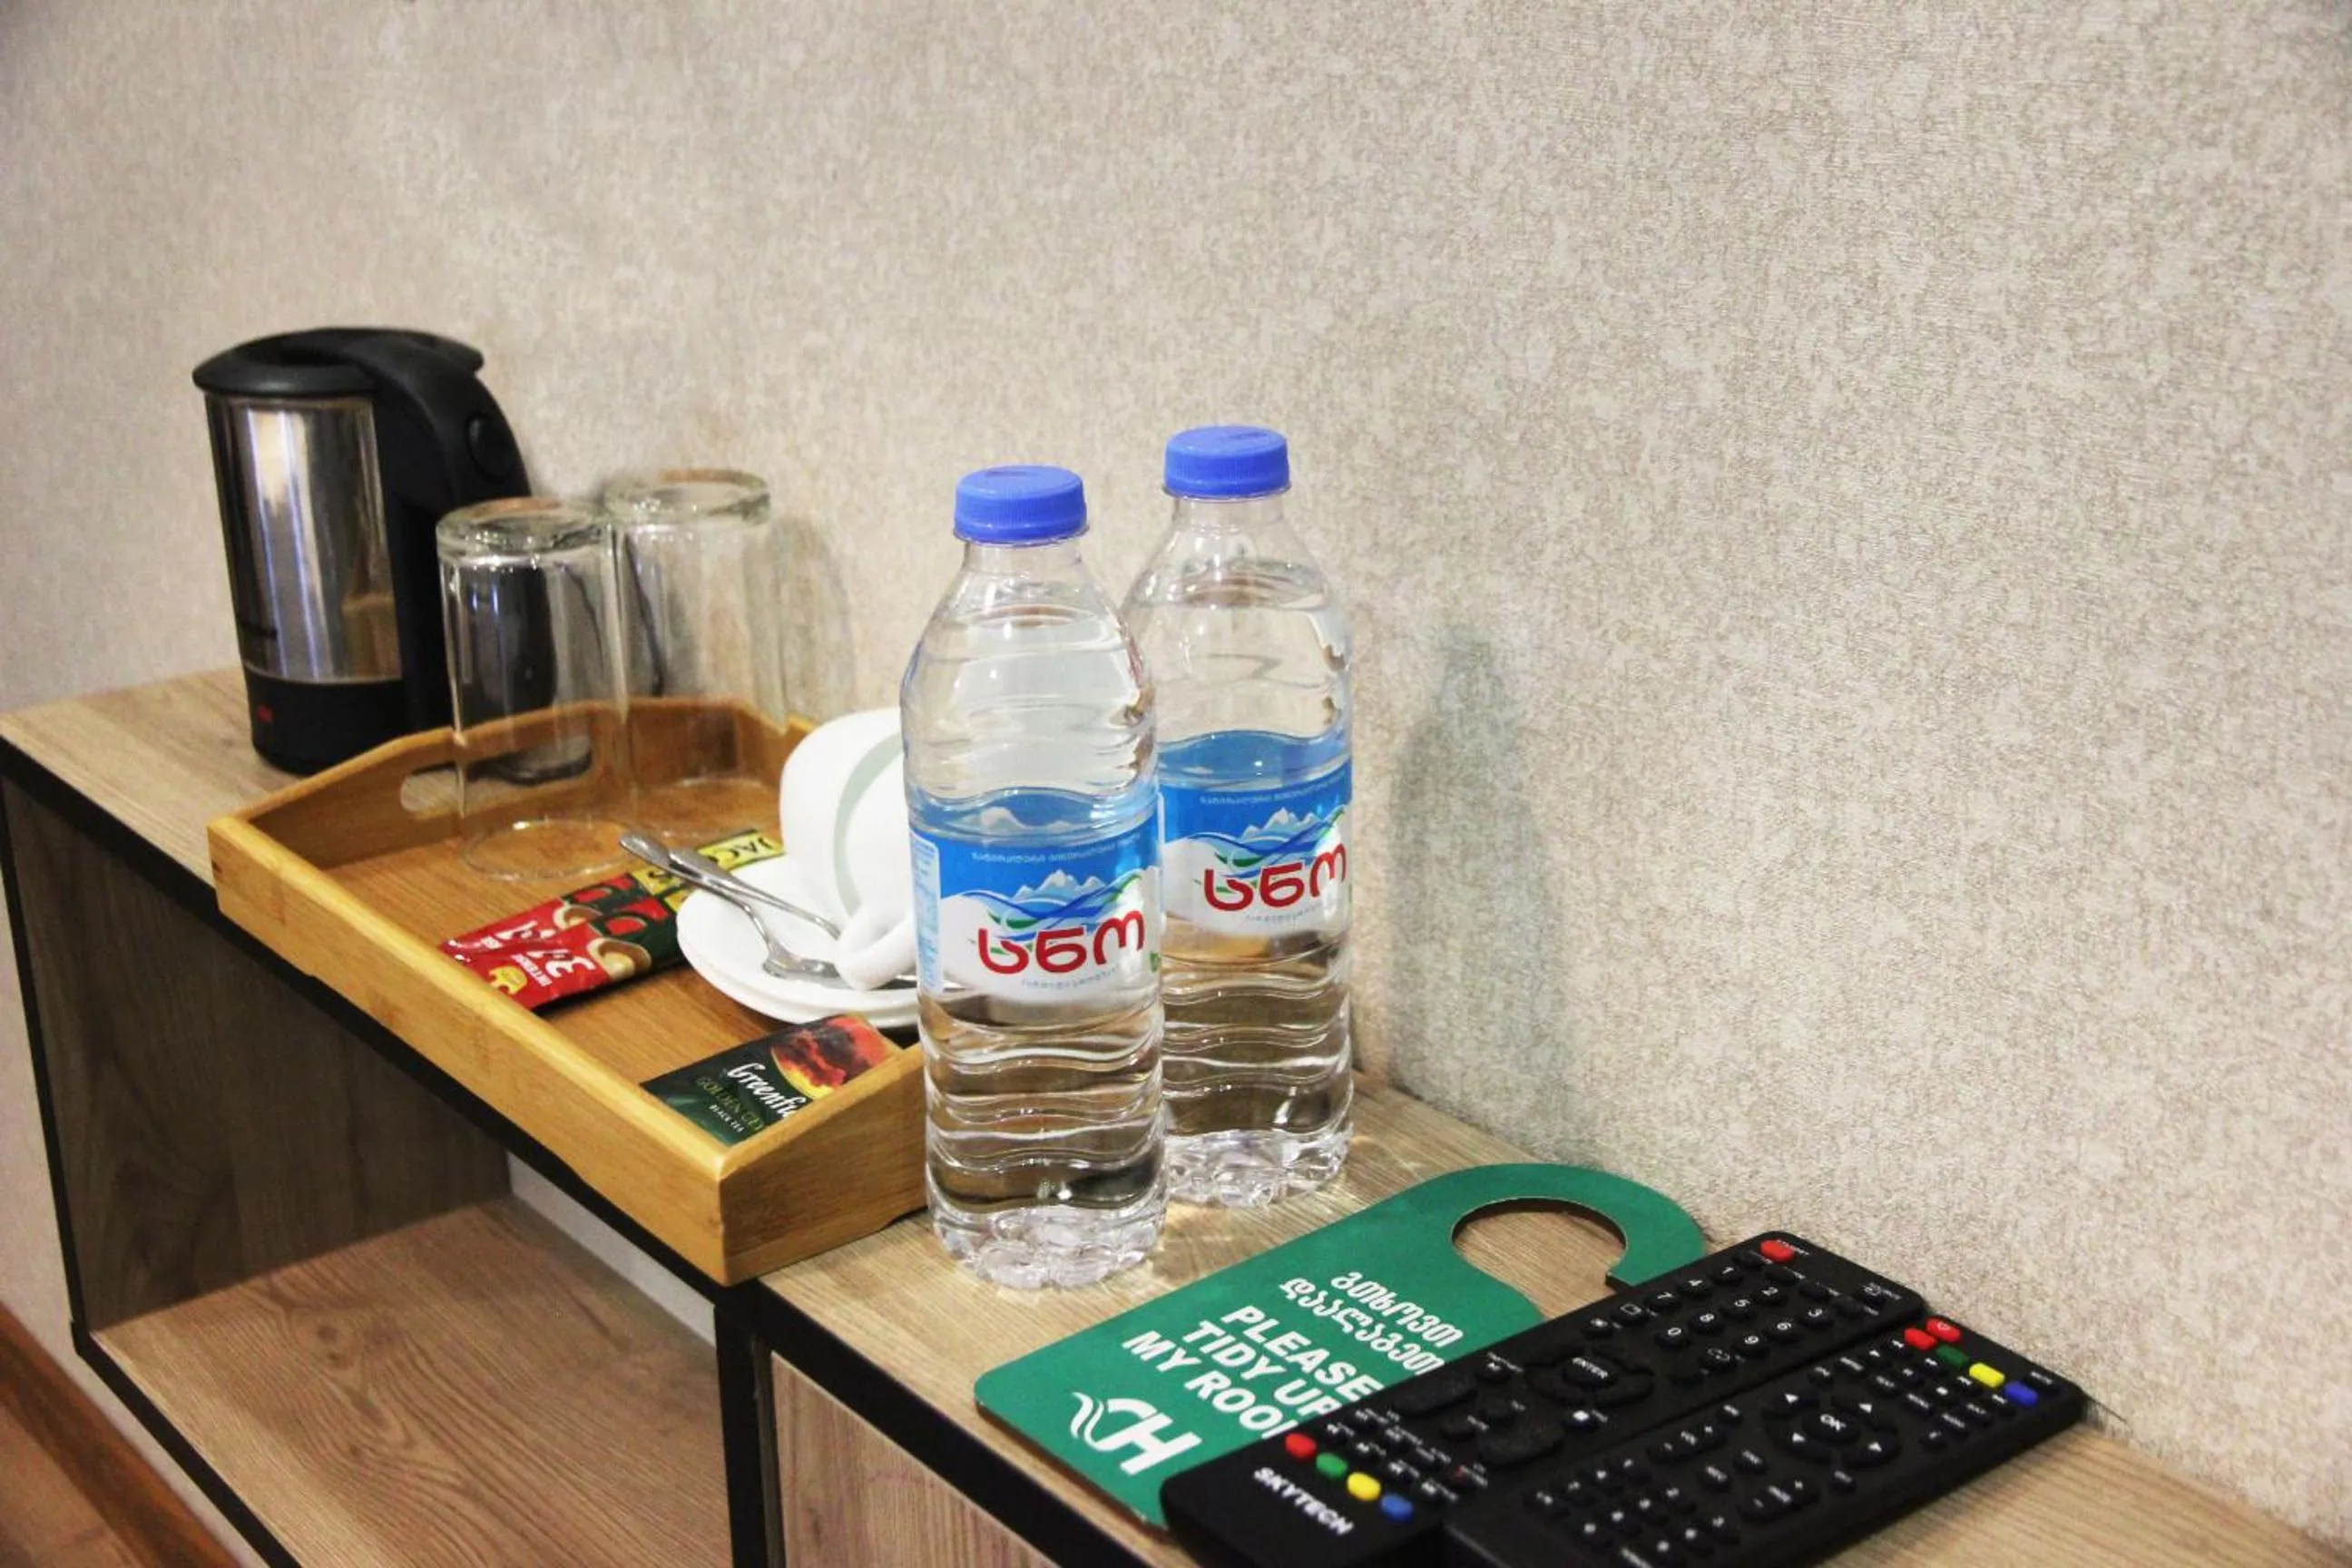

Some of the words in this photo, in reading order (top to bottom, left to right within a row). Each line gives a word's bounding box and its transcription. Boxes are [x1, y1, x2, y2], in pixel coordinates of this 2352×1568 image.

[1205, 843, 1347, 912] სნო
[978, 910, 1145, 975] სნო
[1330, 1271, 1464, 1348] გთხოვთ
[1122, 1330, 1201, 1373] MY
[1182, 1320, 1287, 1380] TIDY
[1220, 1305, 1385, 1402] PLEASE
[1819, 1413, 1847, 1431] OK
[1253, 1466, 1354, 1535] SKYTECH
